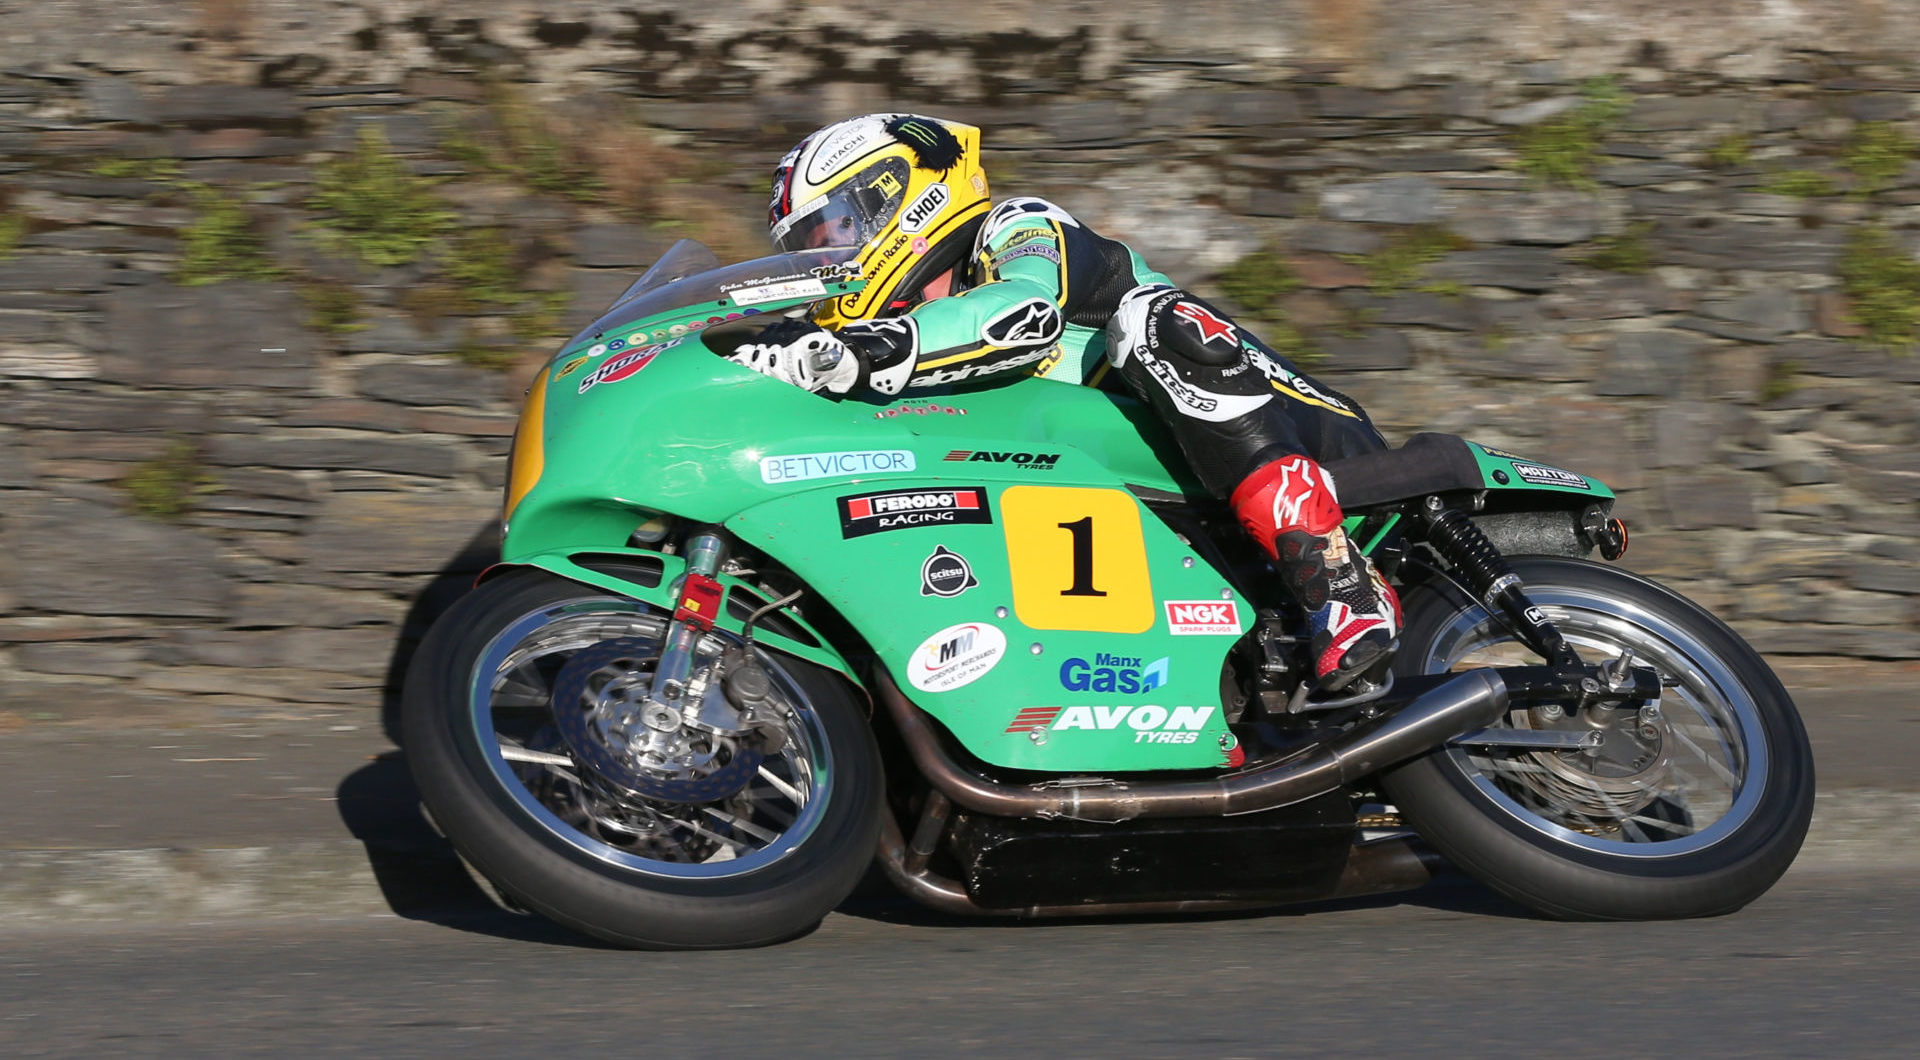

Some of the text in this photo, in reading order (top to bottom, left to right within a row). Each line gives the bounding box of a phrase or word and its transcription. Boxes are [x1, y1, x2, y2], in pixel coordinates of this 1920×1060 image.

[820, 134, 865, 172] HITACHI
[905, 187, 945, 228] SHOEI
[882, 235, 909, 260] Radio
[719, 283, 743, 293] John
[744, 273, 807, 286] McGuinness
[1147, 291, 1185, 349] RACING AHEAD
[767, 452, 909, 481] BETVICTOR
[968, 450, 1061, 465] AVON
[1517, 464, 1582, 483] MAXTON
[875, 493, 954, 513] FERODO
[878, 511, 955, 528] RACING
[1057, 516, 1108, 597] 1
[929, 568, 964, 580] scitsu
[1173, 604, 1231, 624] NGK
[968, 662, 988, 674] MAN
[1095, 652, 1142, 668] Manx
[1059, 657, 1141, 695] Gas
[1051, 705, 1216, 731] AVON
[1133, 731, 1201, 744] TYRES
